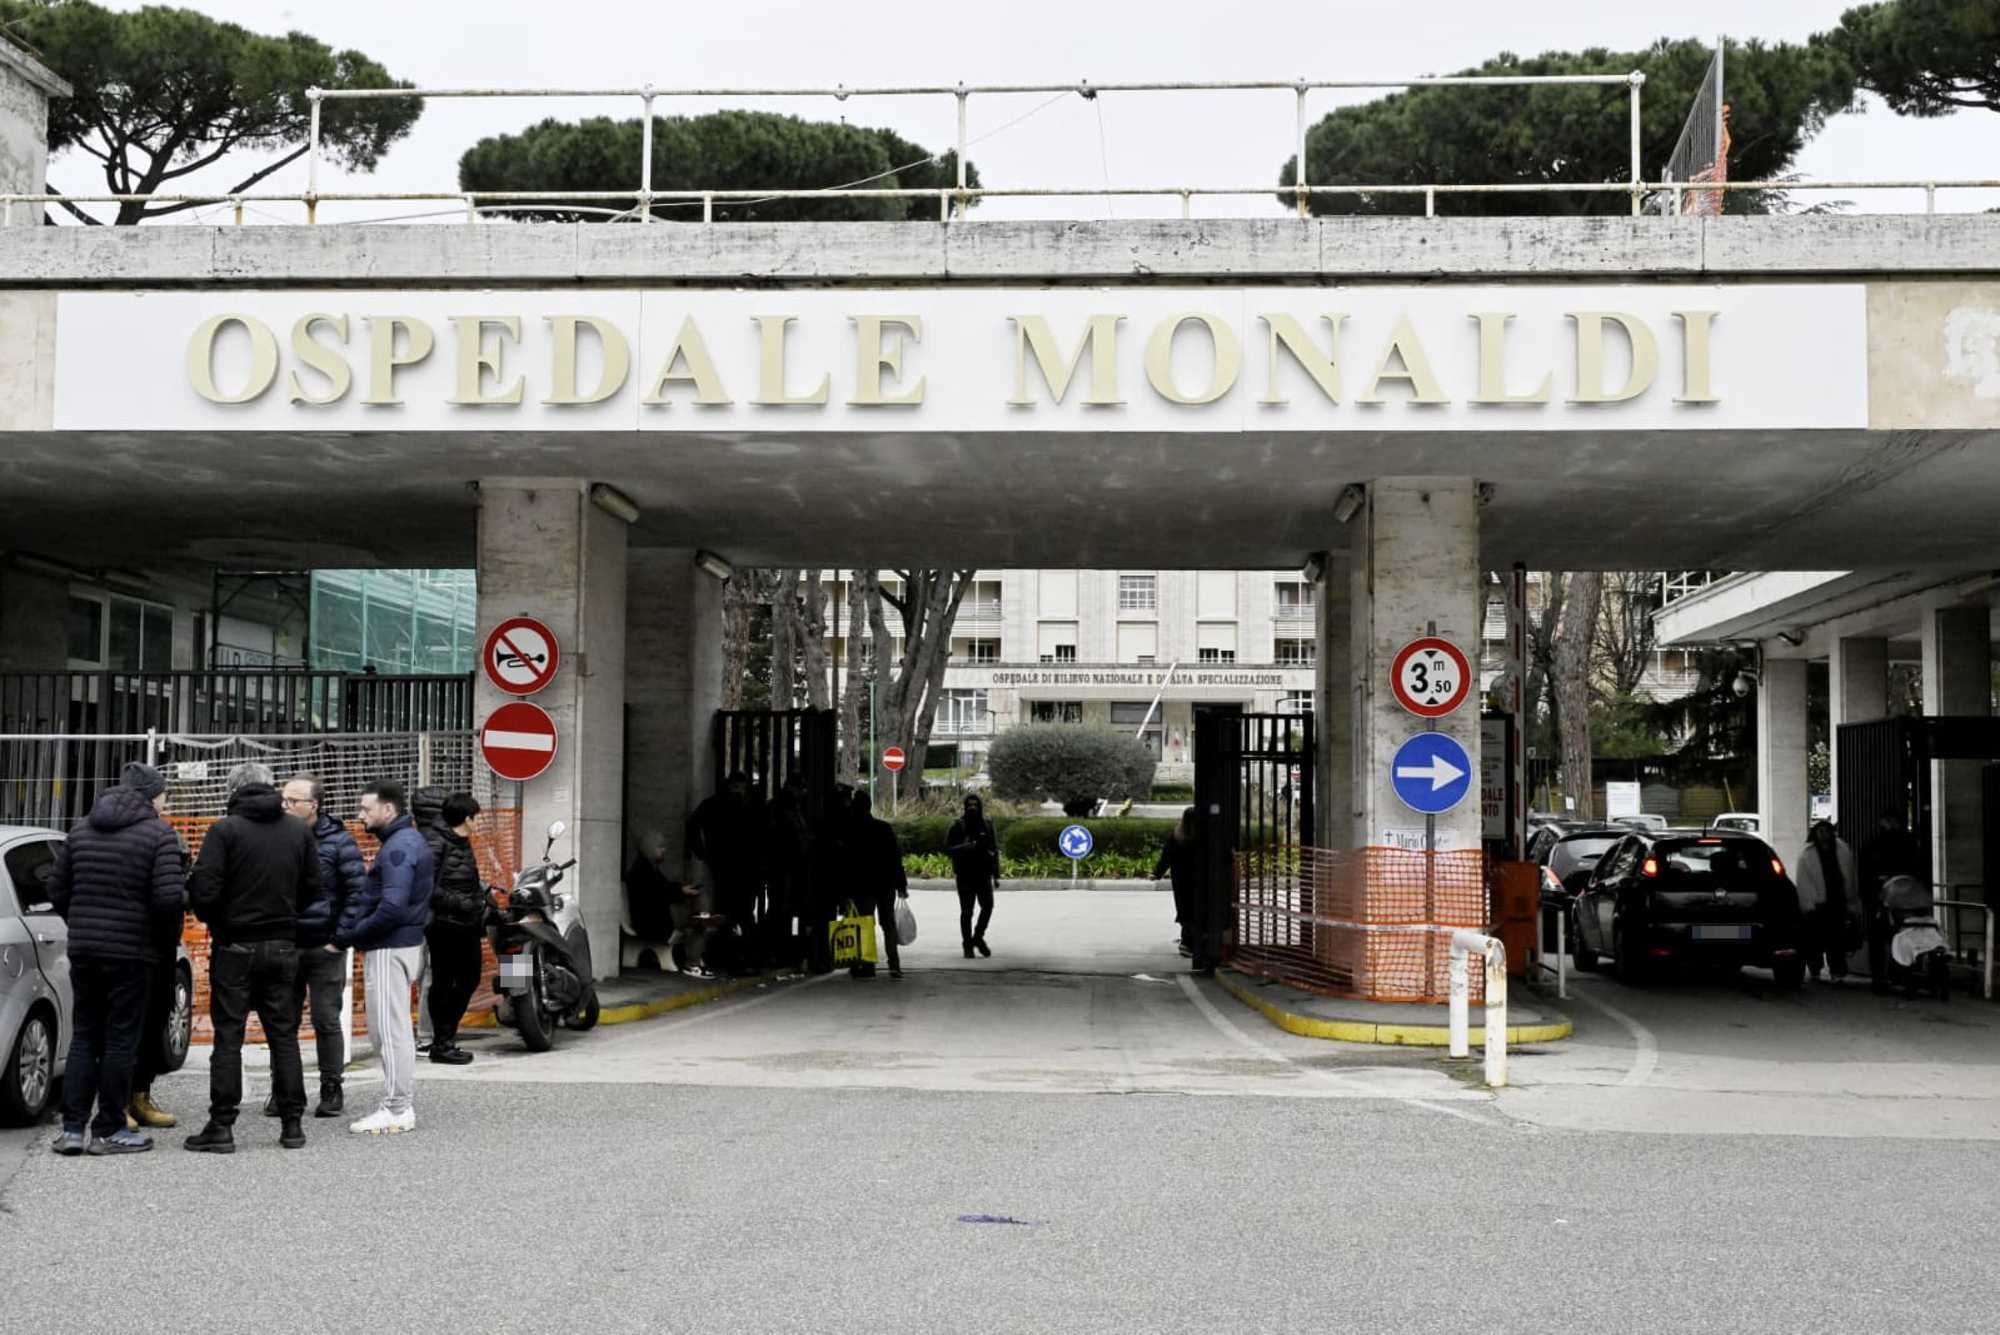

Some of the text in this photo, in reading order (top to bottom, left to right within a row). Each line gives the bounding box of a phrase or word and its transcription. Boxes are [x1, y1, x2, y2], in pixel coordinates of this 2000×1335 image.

[185, 311, 1722, 406] OSPEDALE MONALDI
[992, 673, 1039, 684] OSPEDALE
